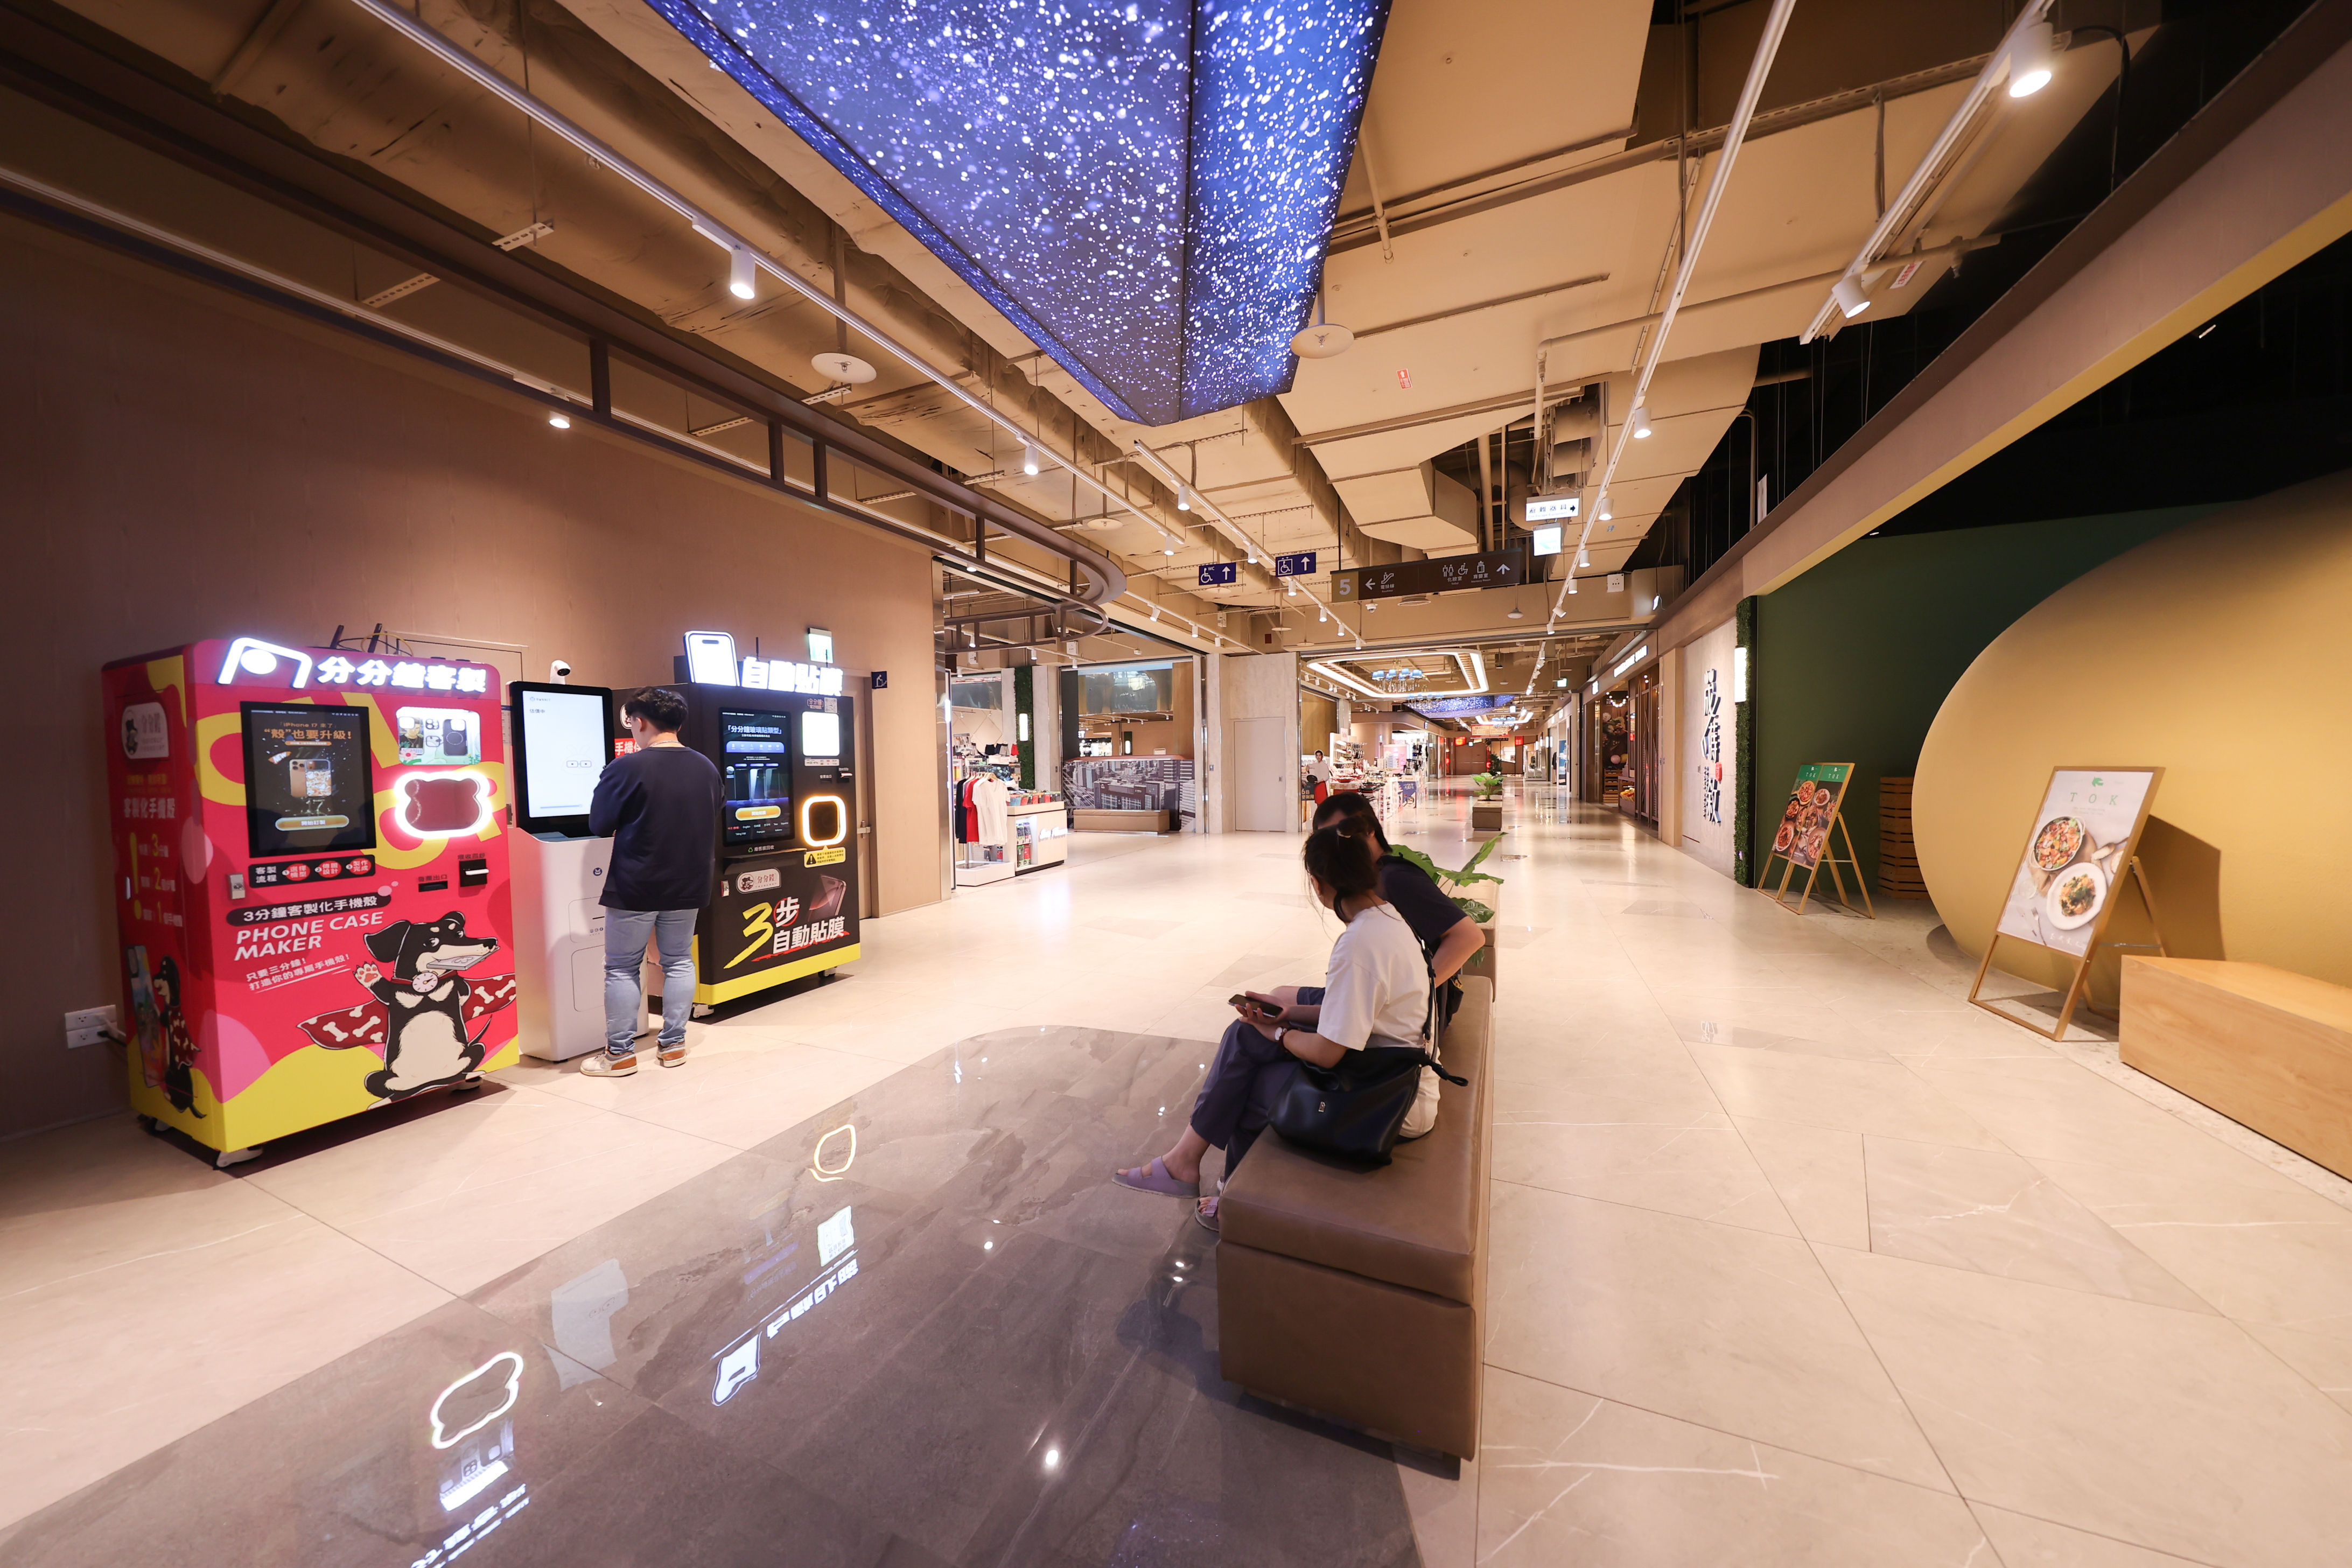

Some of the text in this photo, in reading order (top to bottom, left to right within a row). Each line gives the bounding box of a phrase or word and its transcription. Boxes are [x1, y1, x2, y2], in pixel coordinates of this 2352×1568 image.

[1339, 579, 1351, 596] 5
[317, 655, 487, 693] 分分鐘客製
[2070, 792, 2119, 806] TOK
[255, 865, 276, 874] 客製
[256, 874, 277, 884] 流程
[243, 895, 377, 921] 3分鐘客製化手機殼
[236, 911, 384, 944] PHONE CASE
[773, 916, 845, 954] 自動貼膜
[234, 935, 322, 961] MAKER
